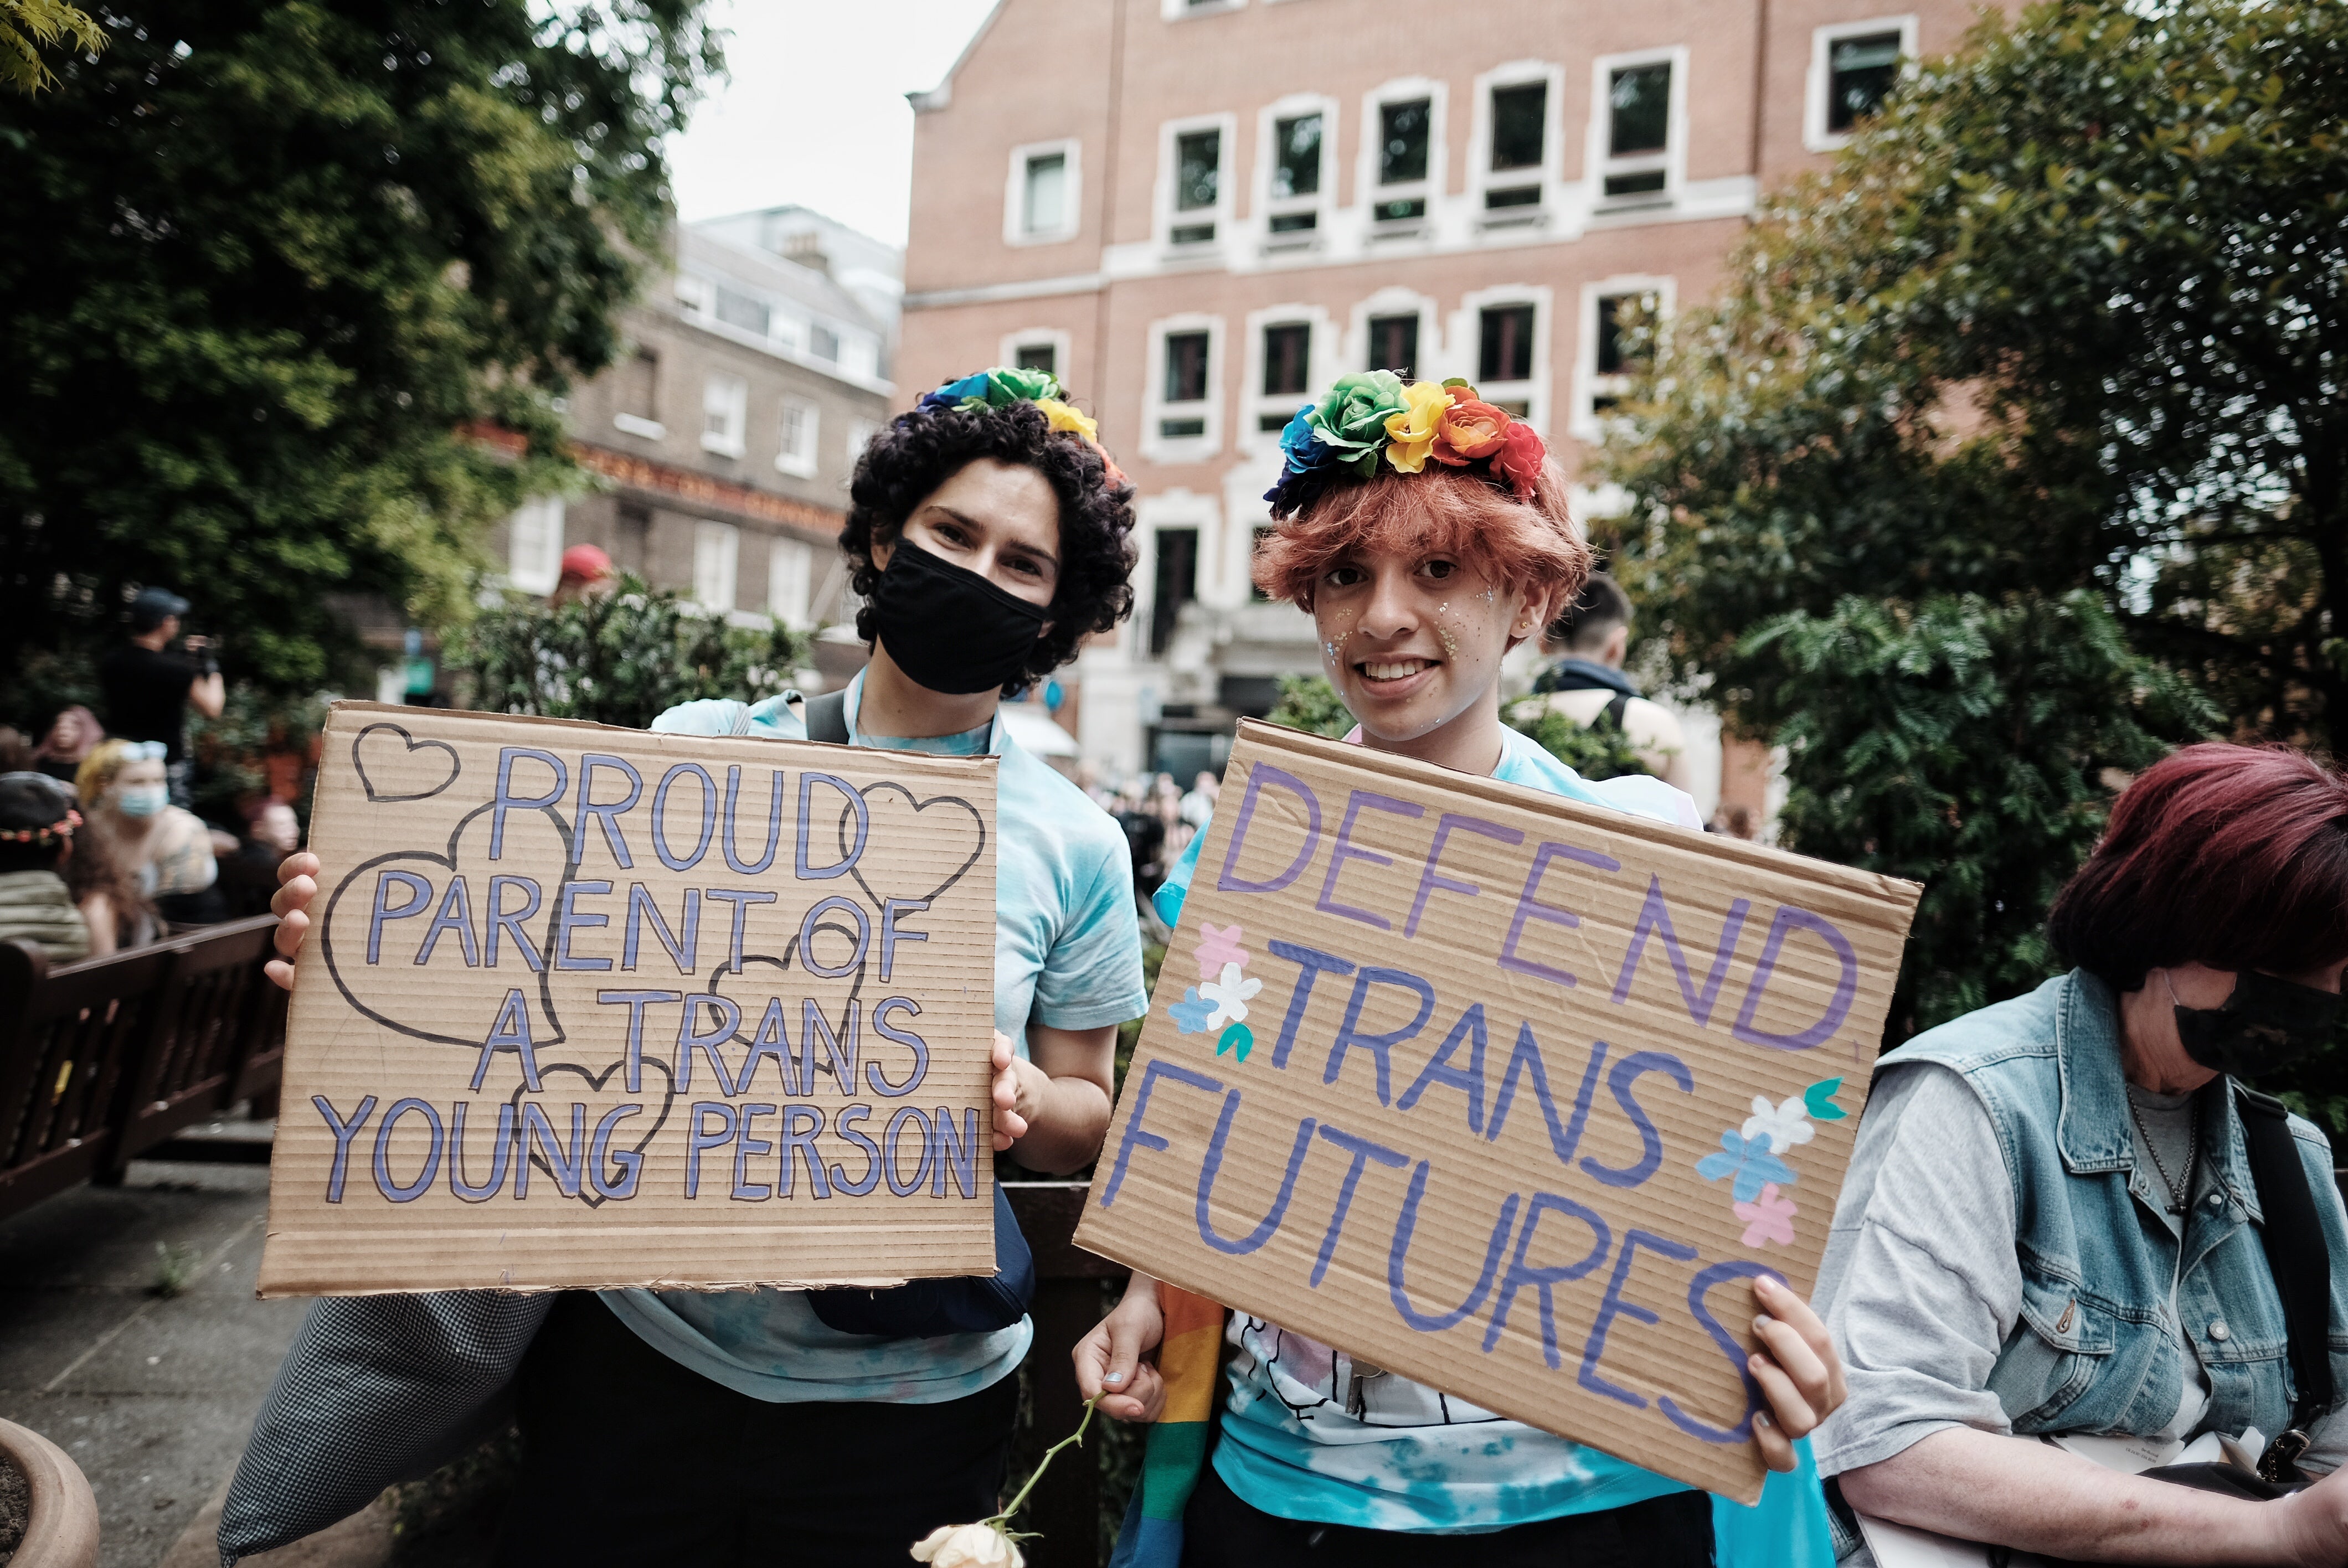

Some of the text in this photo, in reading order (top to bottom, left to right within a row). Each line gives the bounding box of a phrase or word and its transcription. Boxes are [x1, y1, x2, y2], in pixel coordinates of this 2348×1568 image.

[490, 746, 871, 880] PROUD
[365, 870, 931, 983] PARENT OF
[1218, 762, 1858, 1050] DEFEND
[468, 988, 930, 1098] A TRANS
[1267, 940, 1695, 1188] TRANS
[311, 1095, 979, 1204] YOUNG PERSON
[1102, 1059, 1793, 1443] FUTURES
